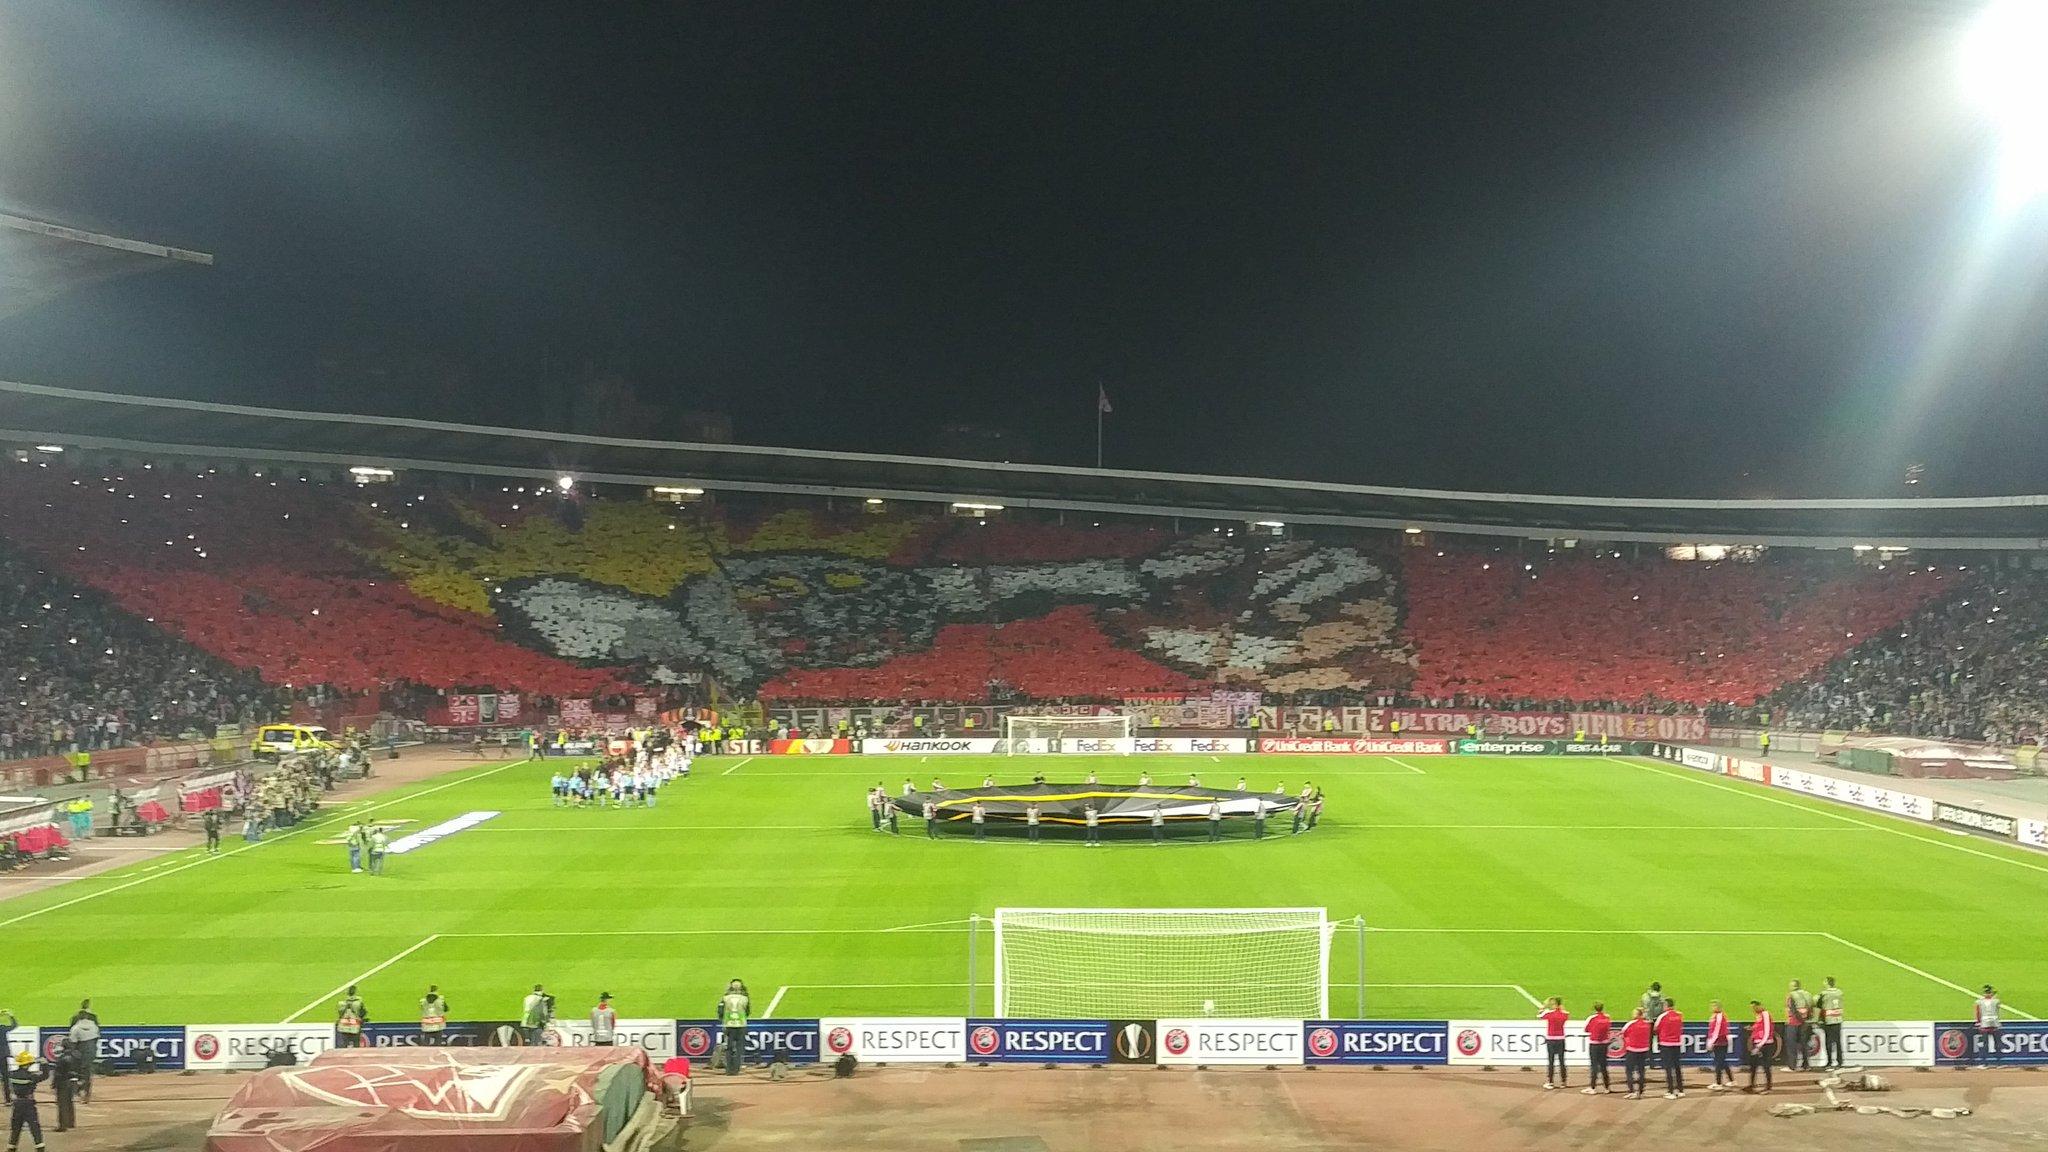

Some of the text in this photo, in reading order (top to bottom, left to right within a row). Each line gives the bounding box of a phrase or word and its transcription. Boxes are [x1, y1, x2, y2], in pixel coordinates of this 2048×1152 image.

[1501, 716, 1565, 735] BOYS
[1077, 739, 1116, 751] FedEx
[1134, 739, 1173, 751] FedEx
[1191, 739, 1230, 751] FedEx
[1276, 741, 1351, 752] UniCredit Bank
[1367, 741, 1443, 753] UniCredit Bank
[1463, 742, 1544, 754] enterprise
[95, 1038, 184, 1058] ESPECT
[572, 1032, 671, 1050] REPECT
[862, 1031, 960, 1049] RESPECT
[1005, 1031, 1107, 1051] RESPECT
[1200, 1033, 1298, 1051] RESPECT
[1343, 1033, 1445, 1052] RESPECT
[1491, 1034, 1590, 1052] RESPCT
[1847, 1034, 1929, 1053] ESPECT
